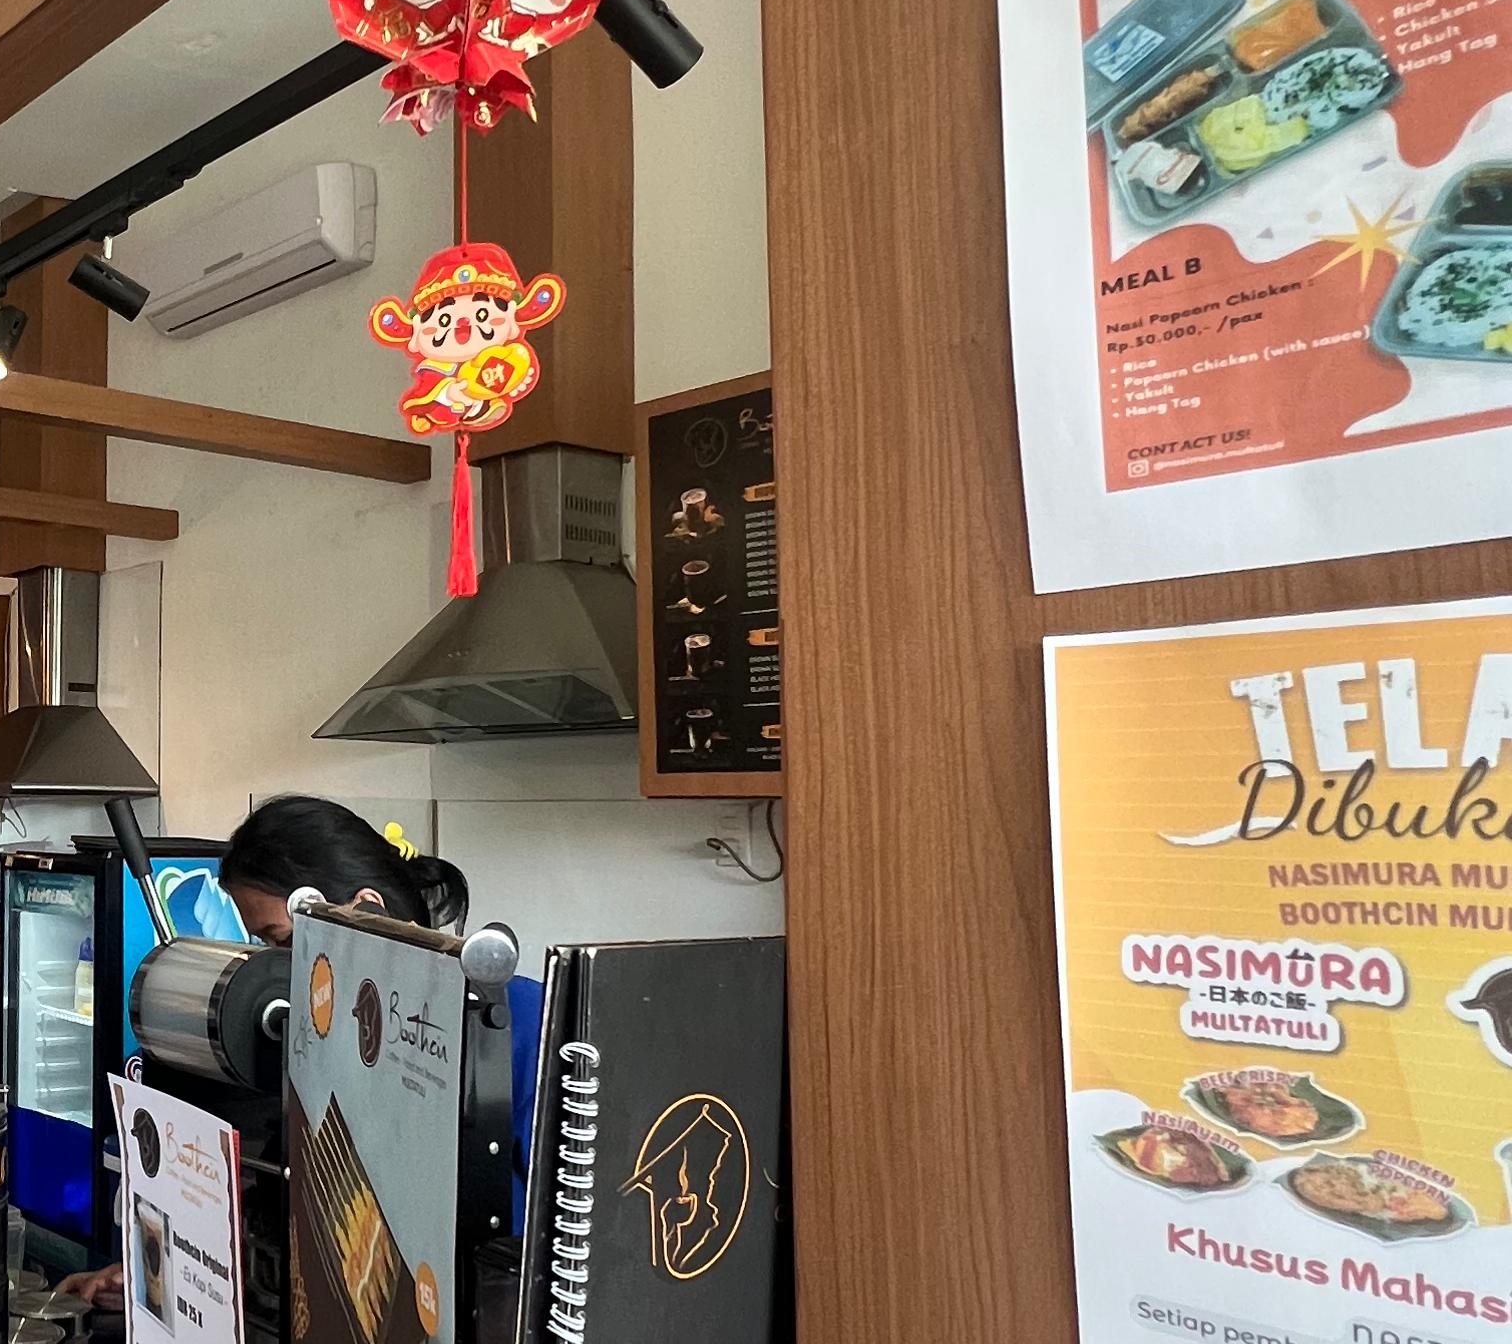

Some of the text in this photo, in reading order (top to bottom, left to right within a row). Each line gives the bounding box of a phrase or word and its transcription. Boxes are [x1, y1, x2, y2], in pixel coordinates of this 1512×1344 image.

[1393, 1, 1479, 37] Chicken
[1395, 25, 1462, 56] Yakult
[1397, 33, 1498, 75] Hang Tag
[1100, 256, 1203, 298] MEAL B
[1105, 316, 1145, 335] Nasi
[1148, 301, 1221, 327] Popcorn
[1226, 279, 1303, 307] Chicken
[1215, 311, 1264, 334] /pax
[1122, 357, 1158, 374] Rice
[1123, 367, 1189, 390] Popcorn
[1191, 350, 1259, 374] Chicken
[1263, 339, 1307, 362] (with
[1125, 384, 1175, 403] Yakult
[1125, 395, 1202, 419] Hang Tag
[1127, 435, 1217, 461] CONTACT
[1237, 756, 1512, 841] Dibuk
[1268, 862, 1441, 889] NASIMURA
[1278, 900, 1438, 928] BOOTHCIN
[1191, 1010, 1328, 1042] MULTATULI
[1141, 1110, 1241, 1154] Nasi Ayam
[1368, 1162, 1452, 1205] POPCORN
[1372, 1149, 1456, 1189] CHICKEN
[1167, 1222, 1512, 1325] Khusus Mahas
[1137, 1301, 1216, 1337] Setiap
